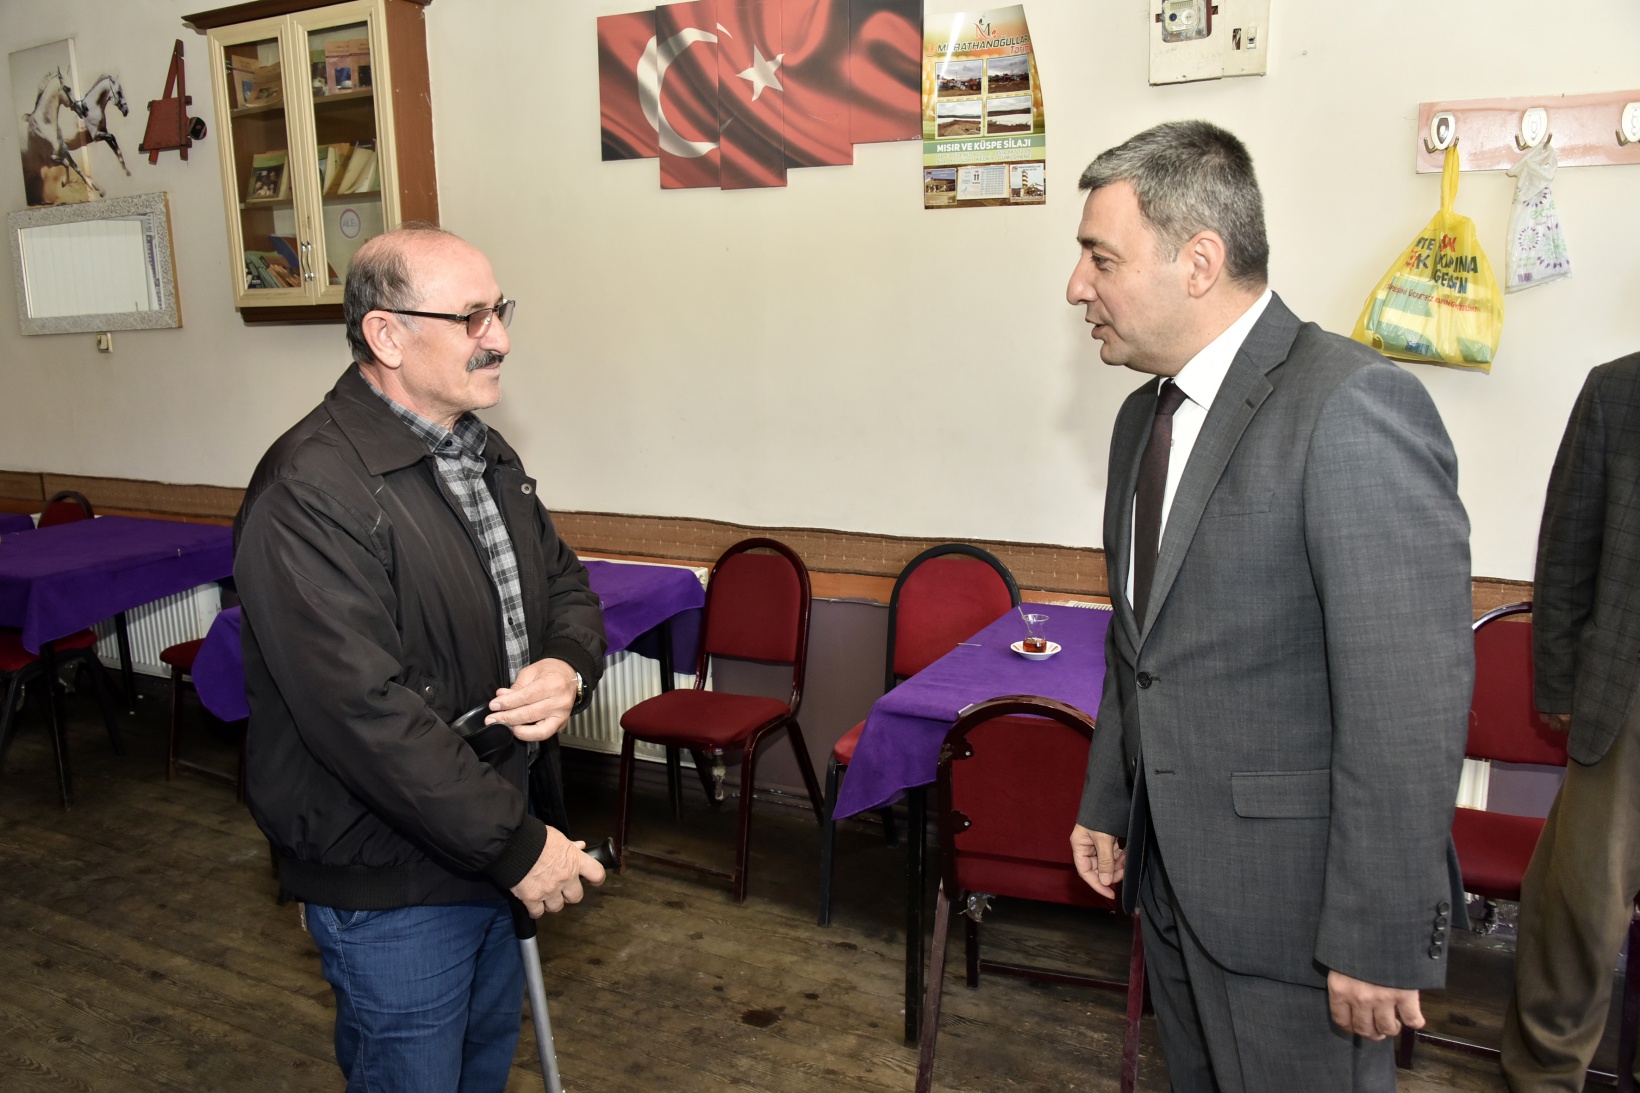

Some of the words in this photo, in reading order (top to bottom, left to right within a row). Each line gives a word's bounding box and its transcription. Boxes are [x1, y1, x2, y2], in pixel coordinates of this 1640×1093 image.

[936, 144, 960, 152] MISIR
[961, 142, 973, 151] VE
[974, 140, 1002, 150] KÜSPE
[1003, 138, 1031, 148] SİLAJI
